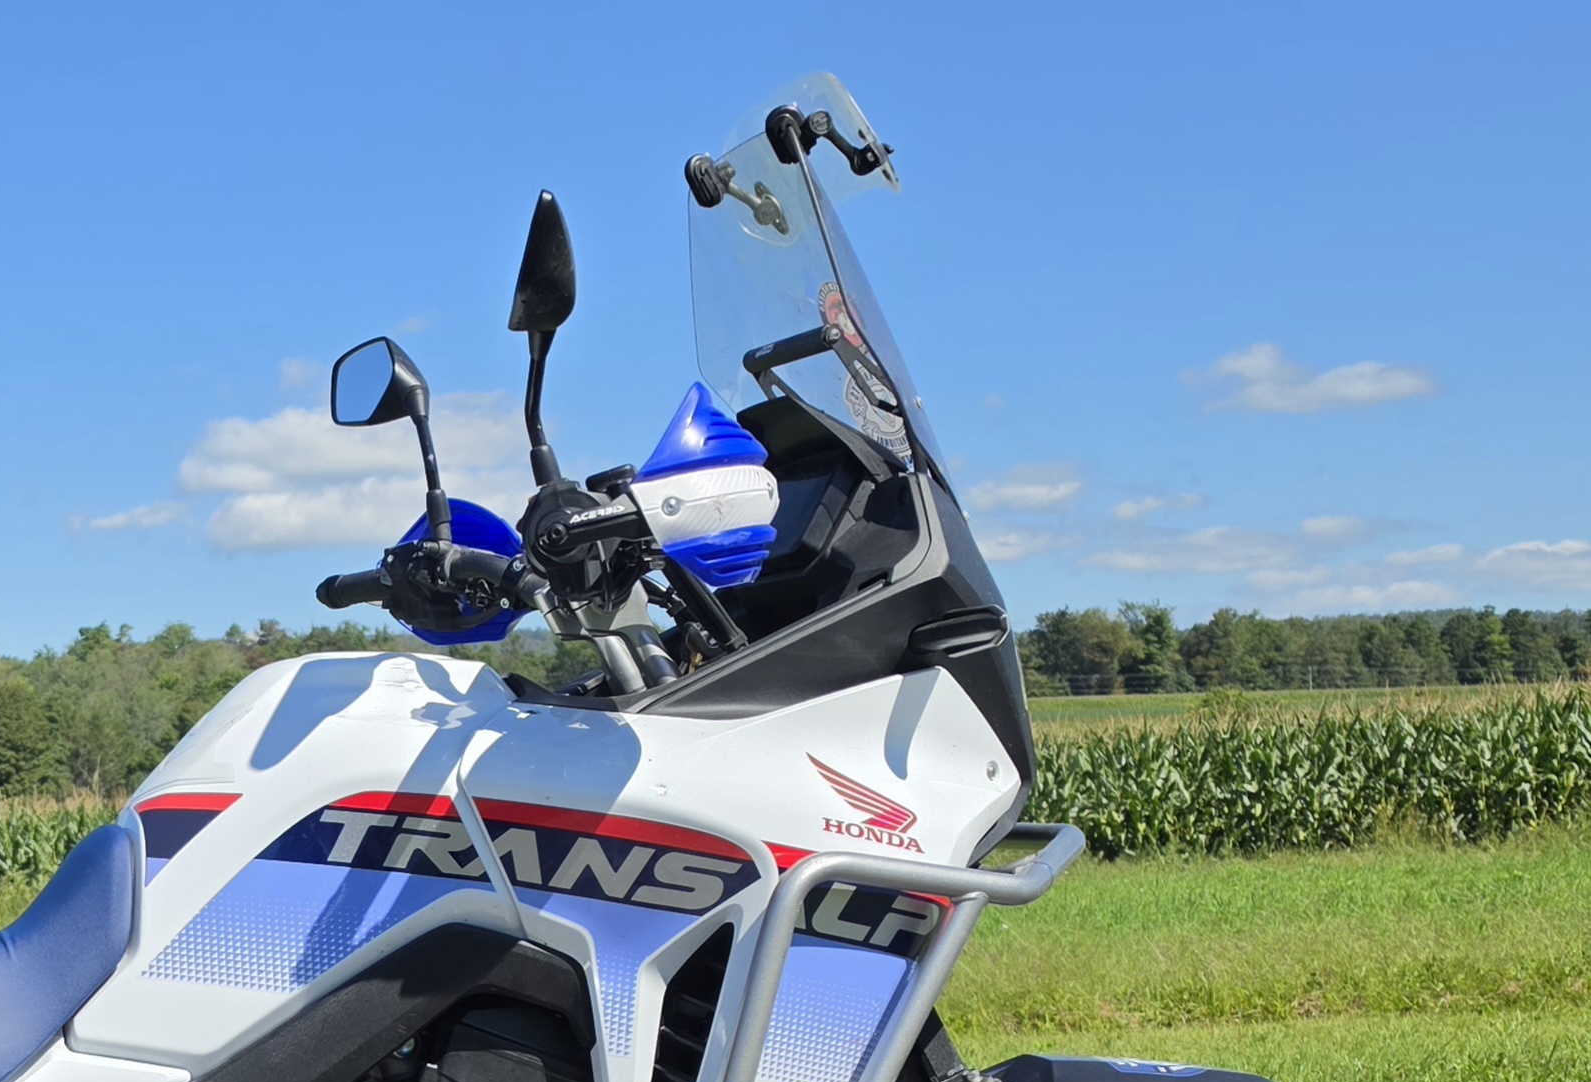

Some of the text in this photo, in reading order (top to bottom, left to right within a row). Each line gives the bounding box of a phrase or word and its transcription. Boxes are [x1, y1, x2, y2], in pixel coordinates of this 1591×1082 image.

[569, 504, 625, 524] ACERBIS
[822, 817, 925, 854] HONDA
[319, 809, 940, 947] TRANS LP
